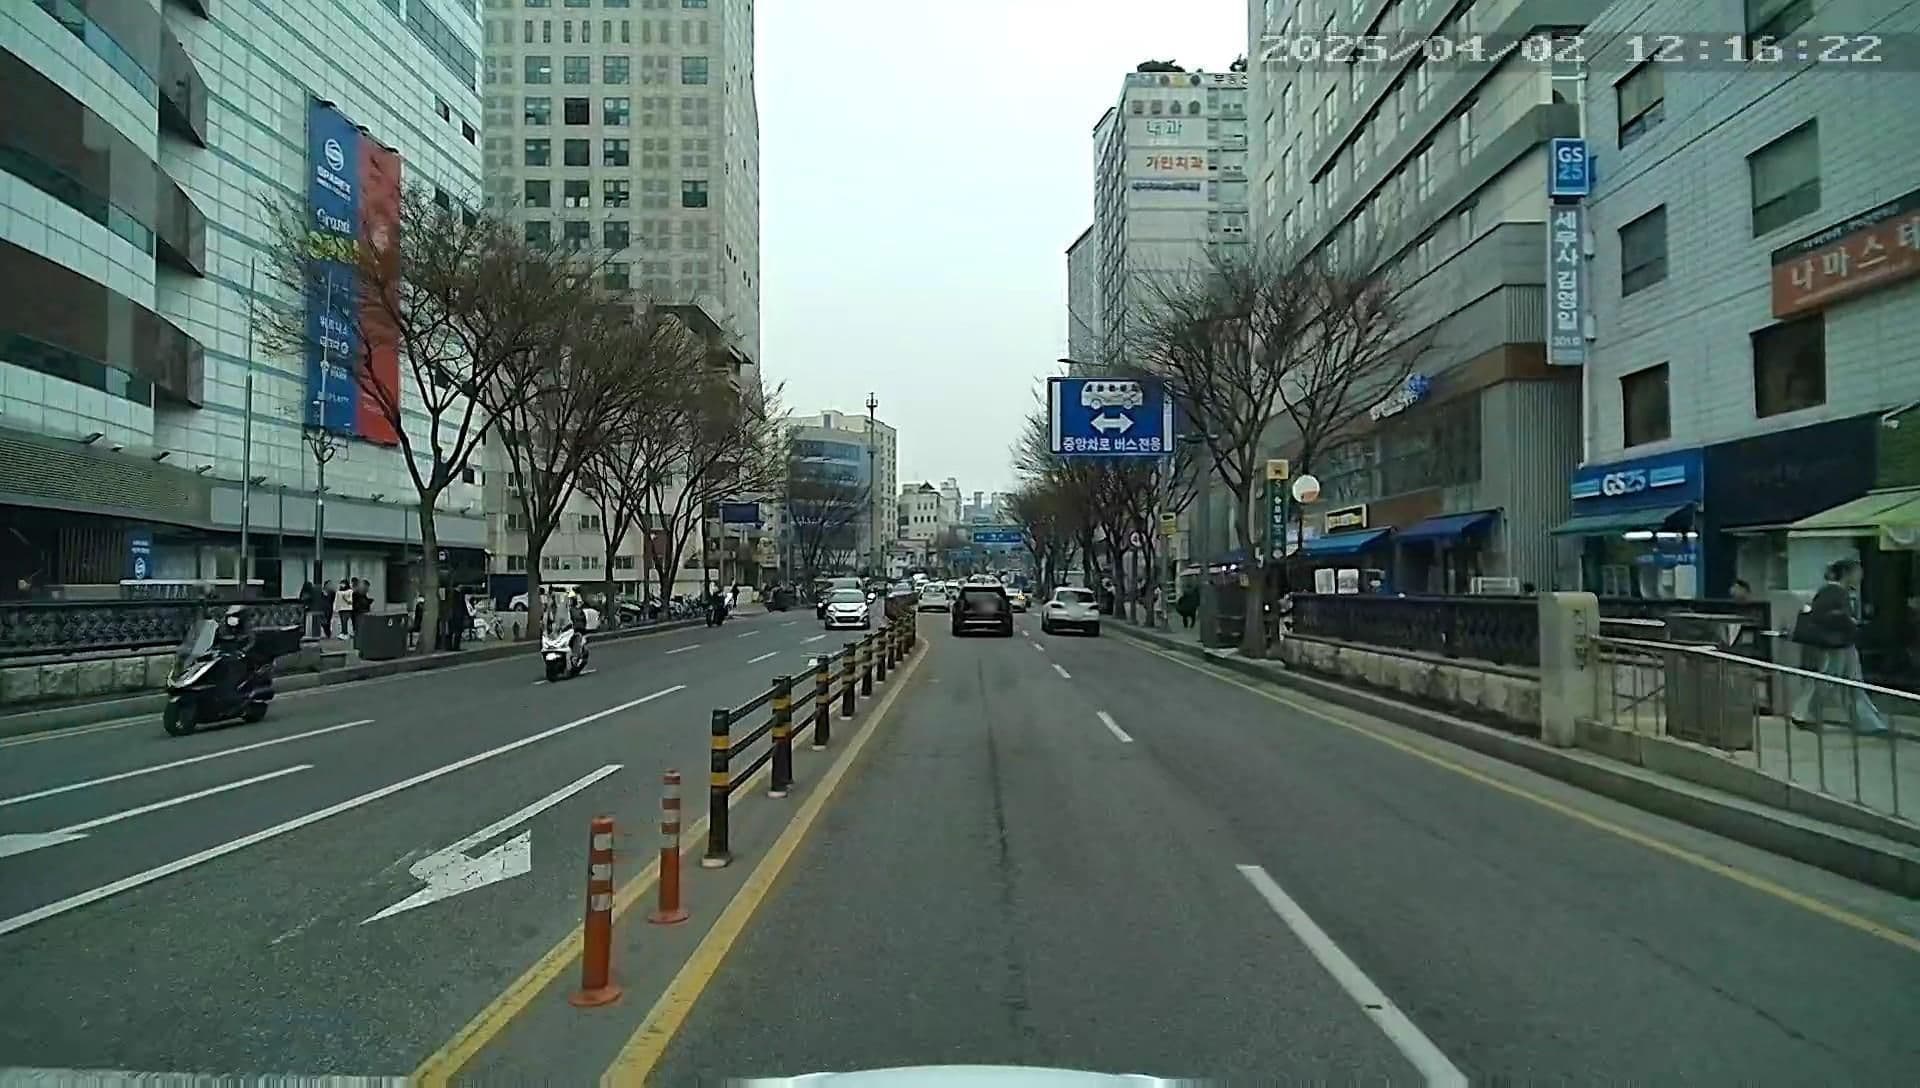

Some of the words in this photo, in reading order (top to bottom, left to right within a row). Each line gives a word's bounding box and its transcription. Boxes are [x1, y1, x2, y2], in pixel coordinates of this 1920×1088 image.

[1558, 147, 1583, 163] GS
[1558, 163, 1583, 180] 25
[1554, 210, 1579, 267] 세무사
[1063, 436, 1111, 452] 중앙차로
[1114, 437, 1161, 452] 버스전용
[1602, 469, 1647, 497] GS25
